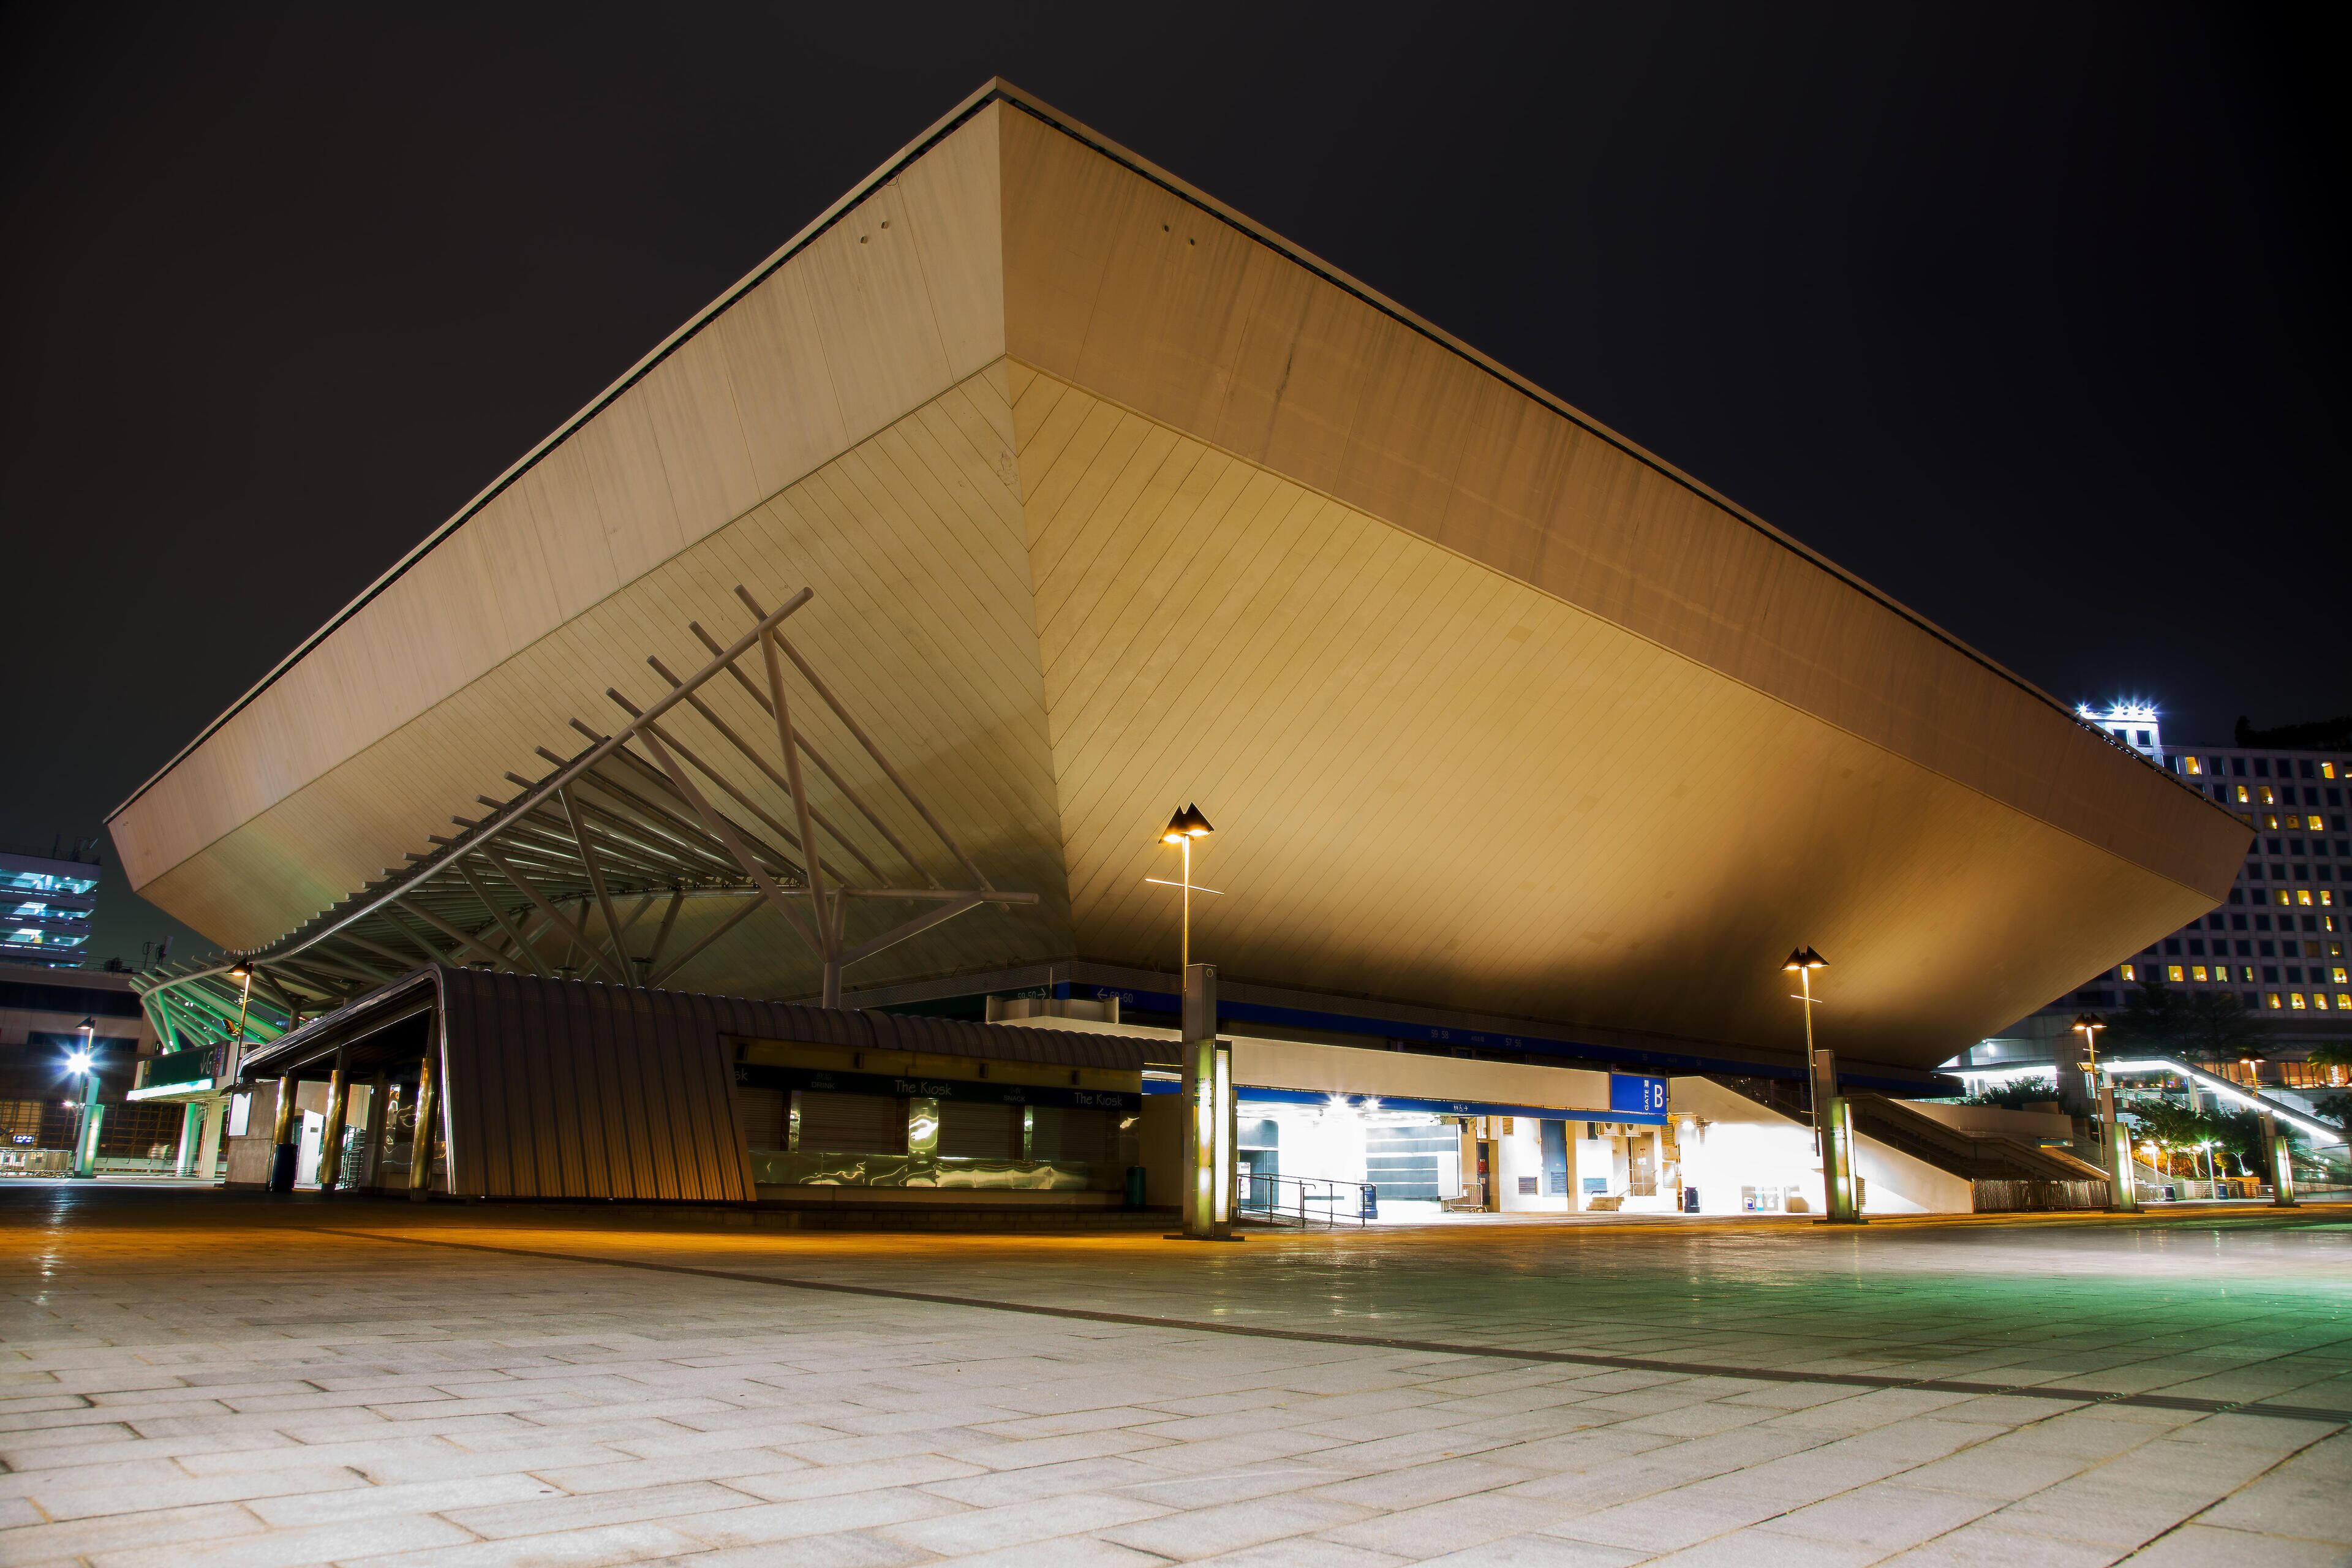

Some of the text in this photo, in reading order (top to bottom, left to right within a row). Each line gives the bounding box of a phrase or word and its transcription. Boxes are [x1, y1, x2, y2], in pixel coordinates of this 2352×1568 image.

[1431, 1029, 1438, 1039] 59
[206, 1050, 213, 1075] G
[810, 1080, 835, 1089] DRINK
[894, 1079, 916, 1093] The
[1003, 1094, 1025, 1103] SNACK
[1074, 1092, 1093, 1104] The
[1654, 1084, 1664, 1108] B
